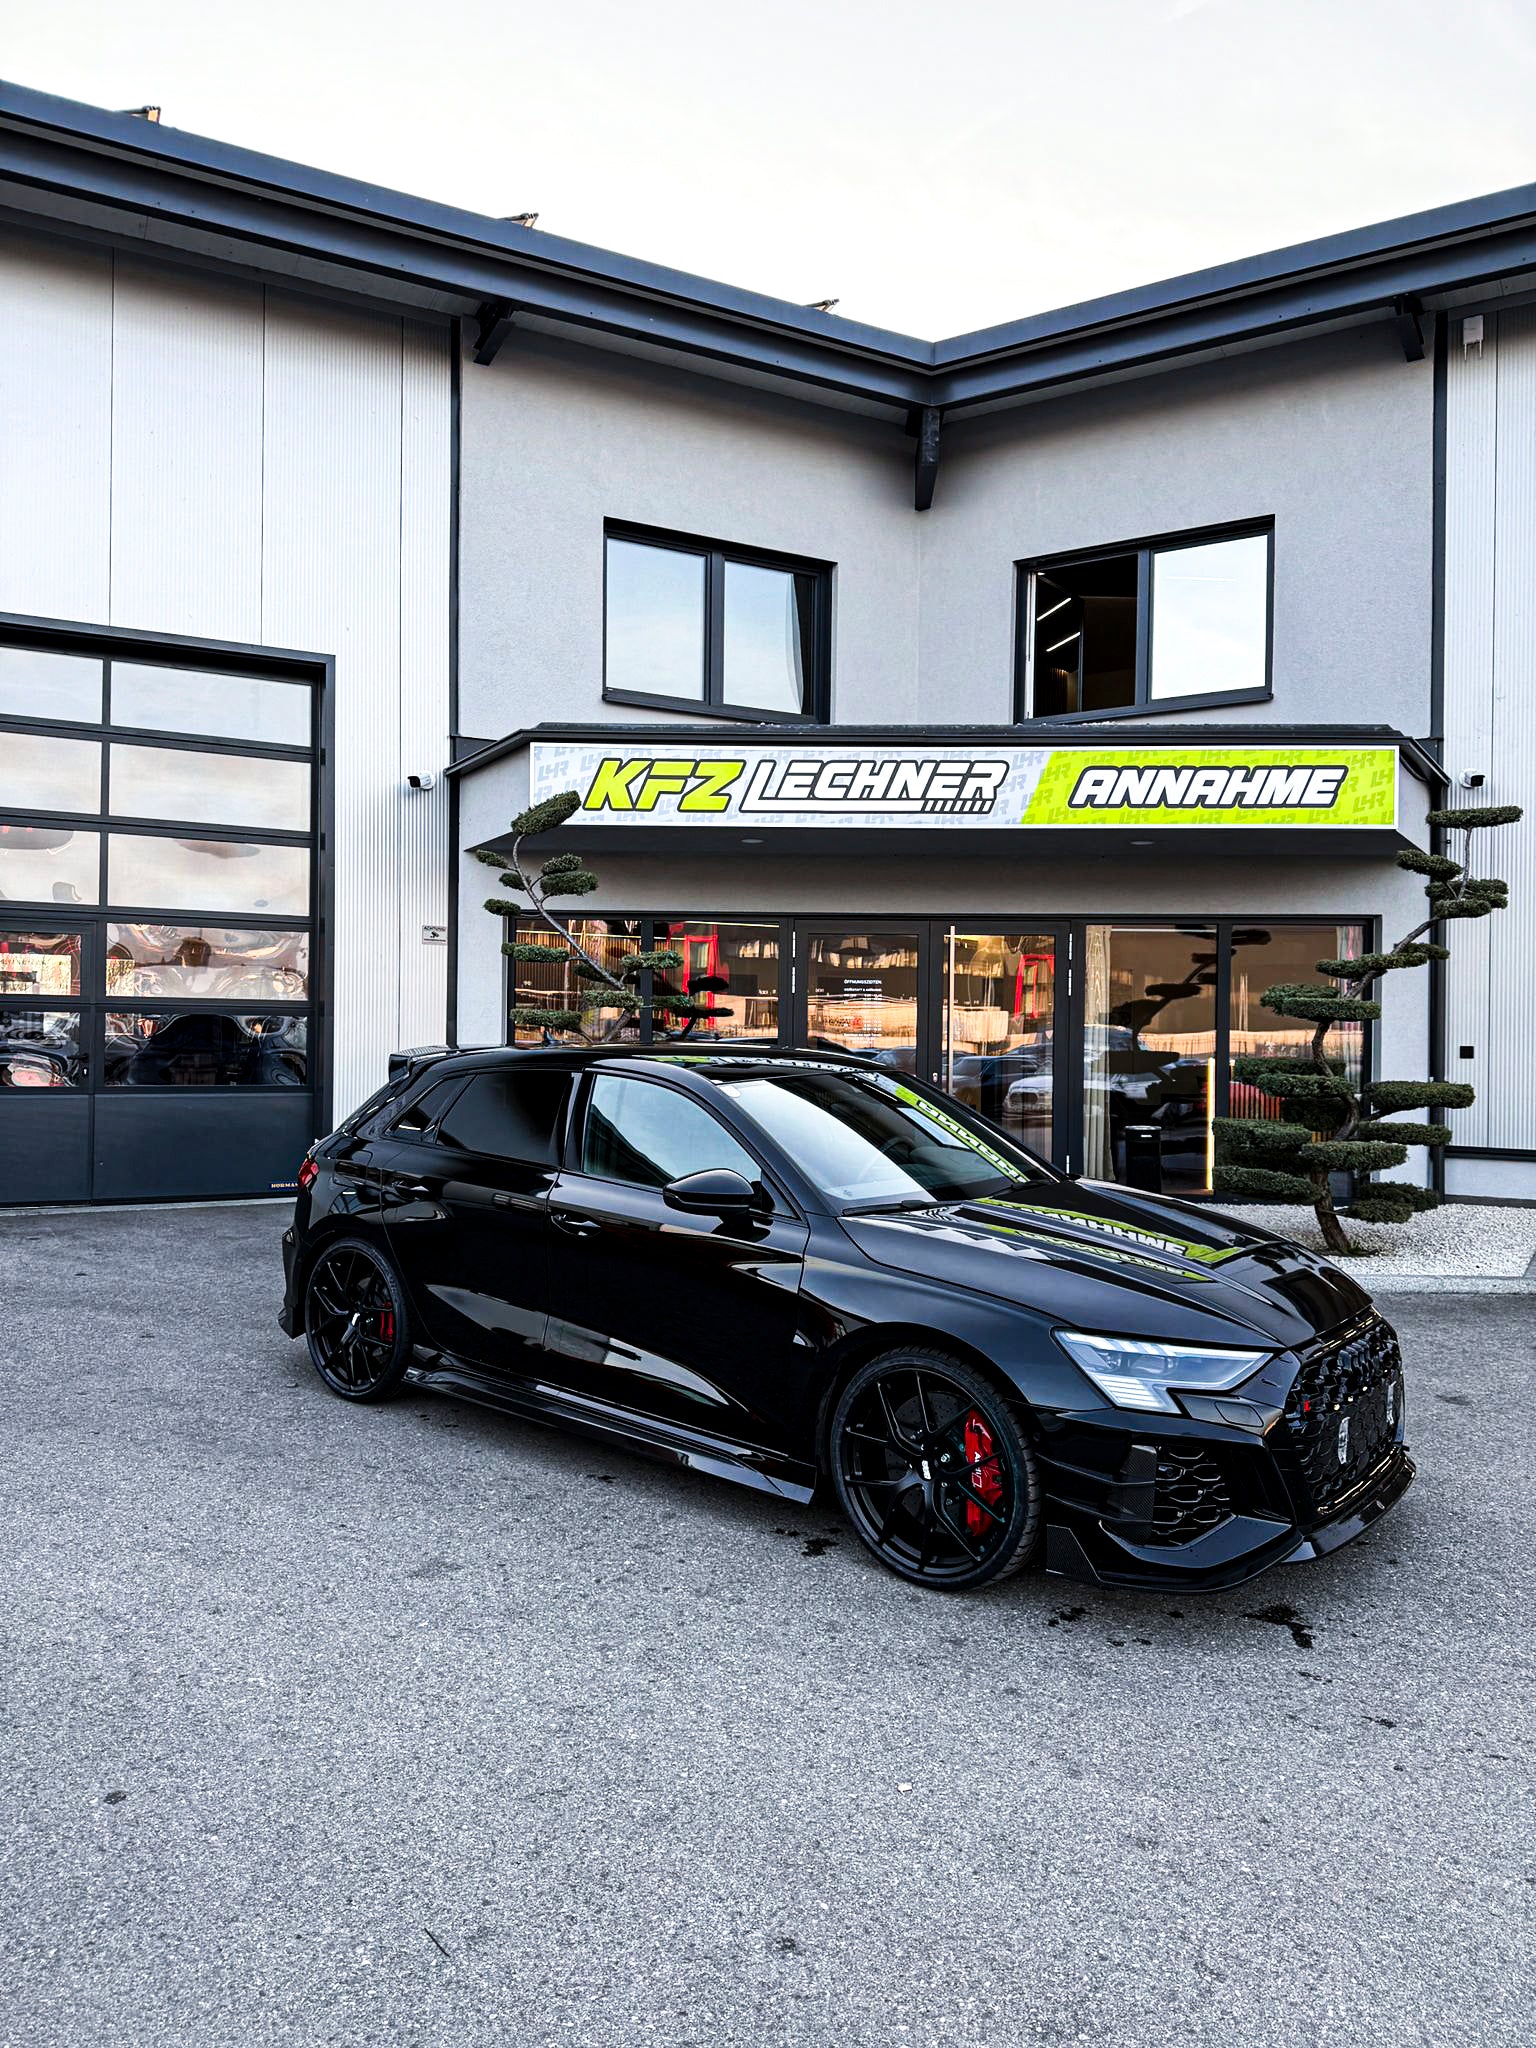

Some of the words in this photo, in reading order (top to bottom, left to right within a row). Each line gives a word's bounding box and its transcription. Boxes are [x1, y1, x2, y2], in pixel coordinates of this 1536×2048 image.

[582, 758, 747, 812] KFZ
[739, 759, 1010, 814] LECHNER
[1067, 765, 1349, 808] ANNAHME
